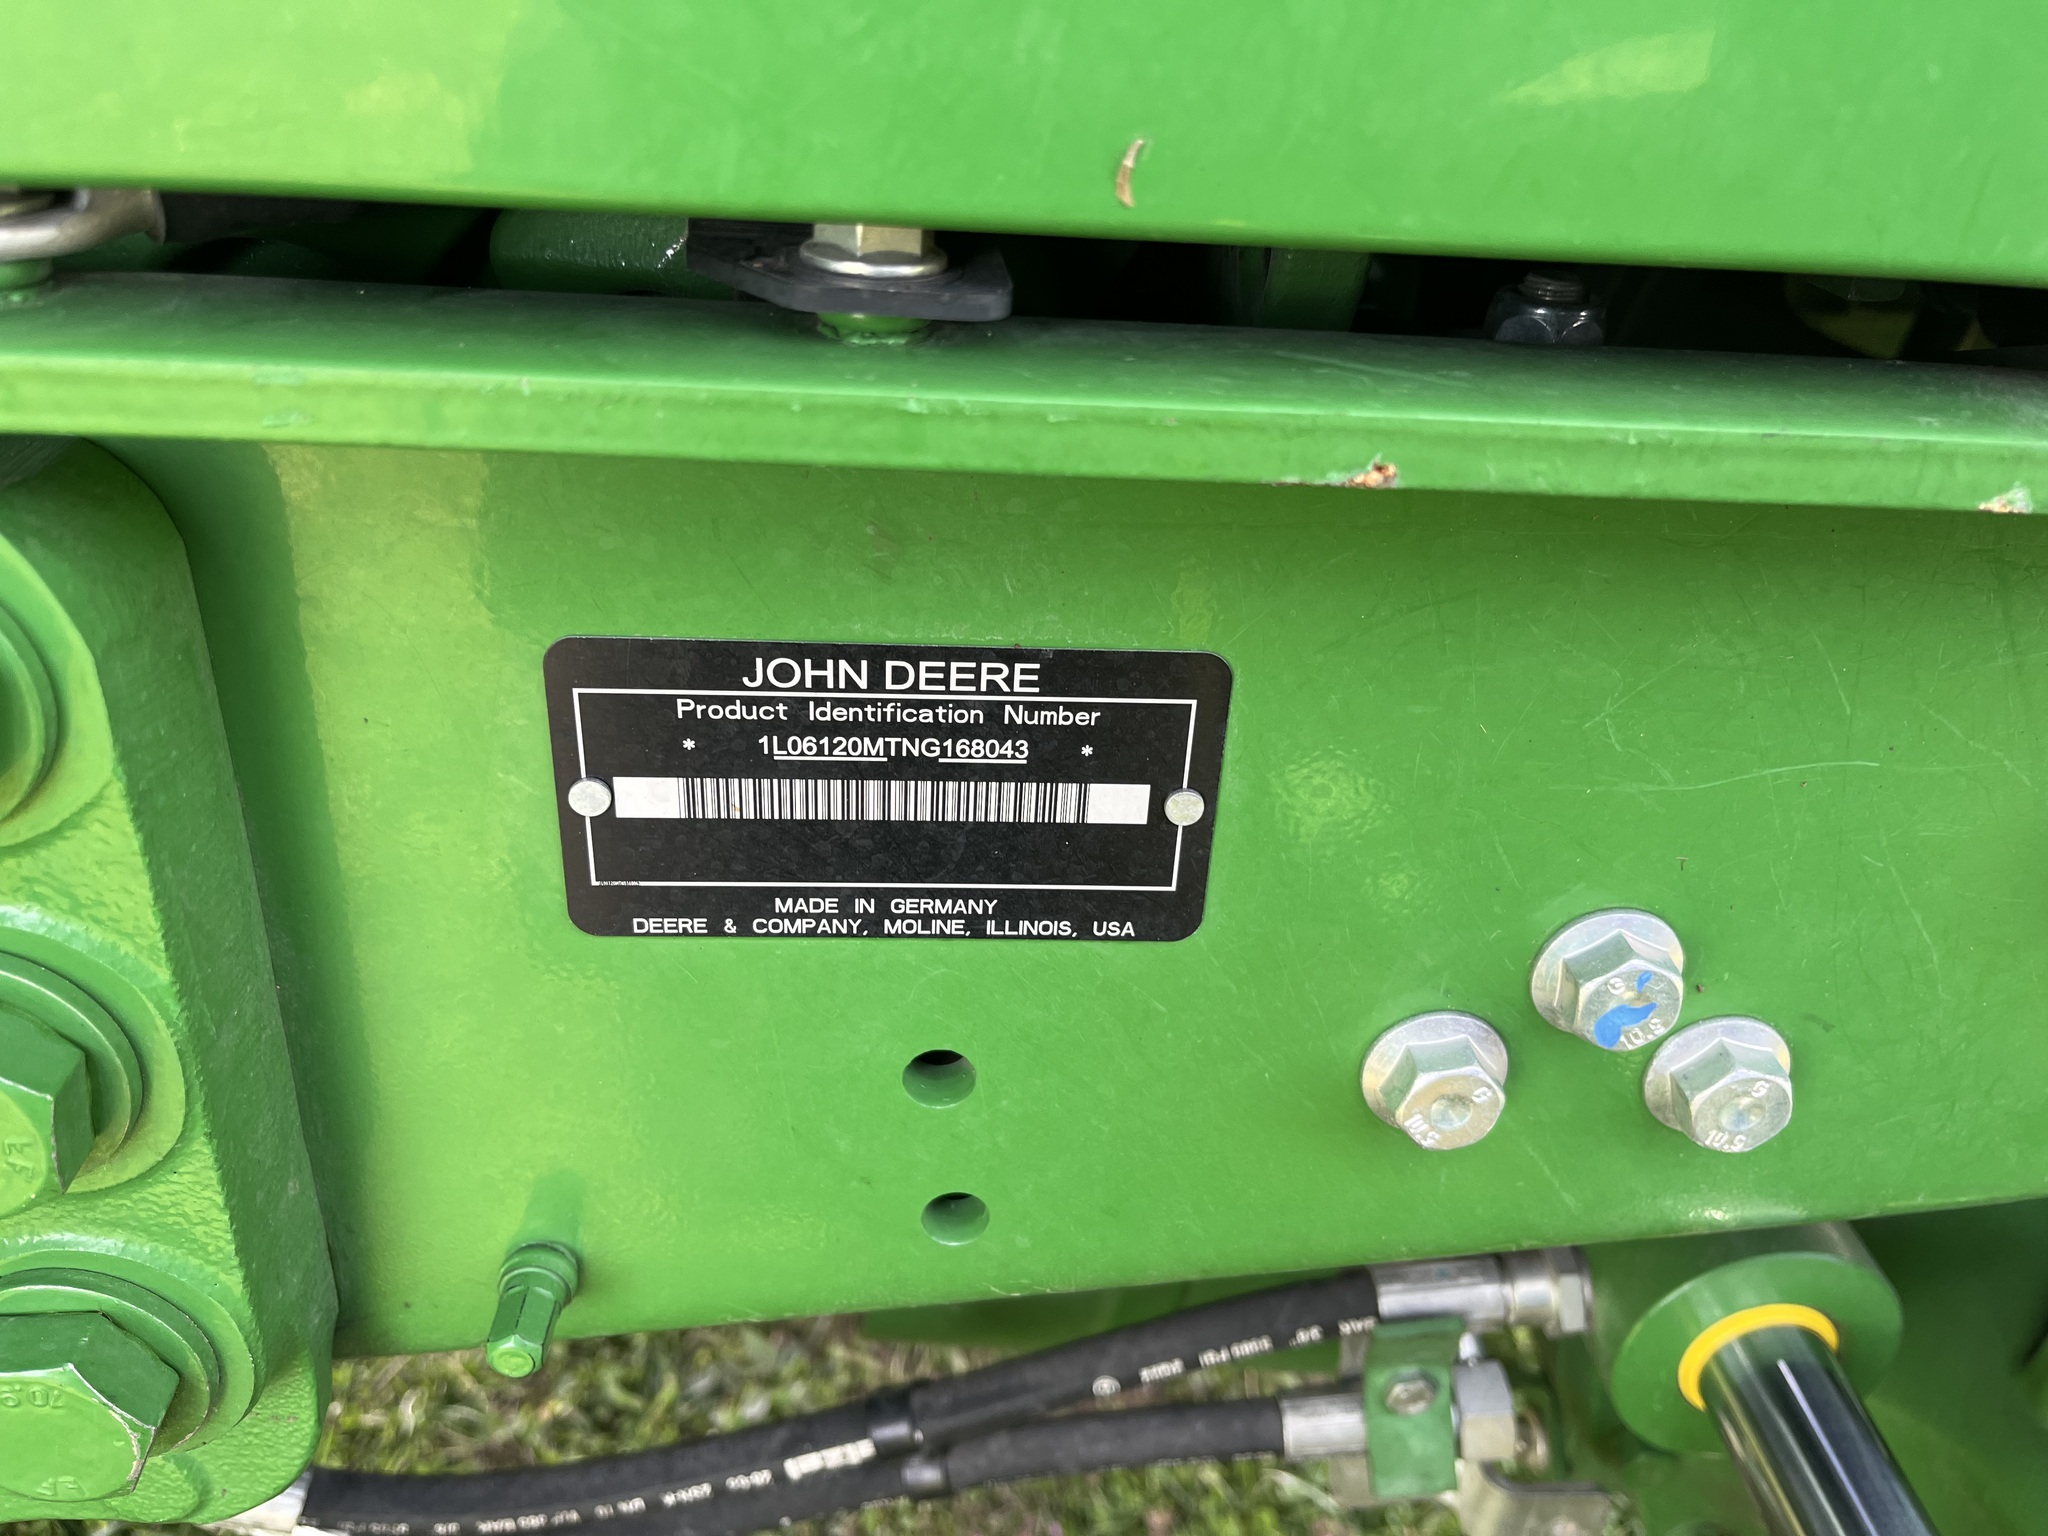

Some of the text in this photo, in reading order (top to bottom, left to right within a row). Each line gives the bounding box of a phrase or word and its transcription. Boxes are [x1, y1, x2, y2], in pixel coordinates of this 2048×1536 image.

[742, 657, 1041, 693] JOHN DEERE
[676, 698, 1101, 726] Product Identification Number
[758, 735, 1029, 760] 1L06120MTNG168043
[774, 897, 998, 915] MADE IN GERMANY
[632, 917, 1136, 938] DEERE & COMPANY, MOLINE, ILLINOIS, USA
